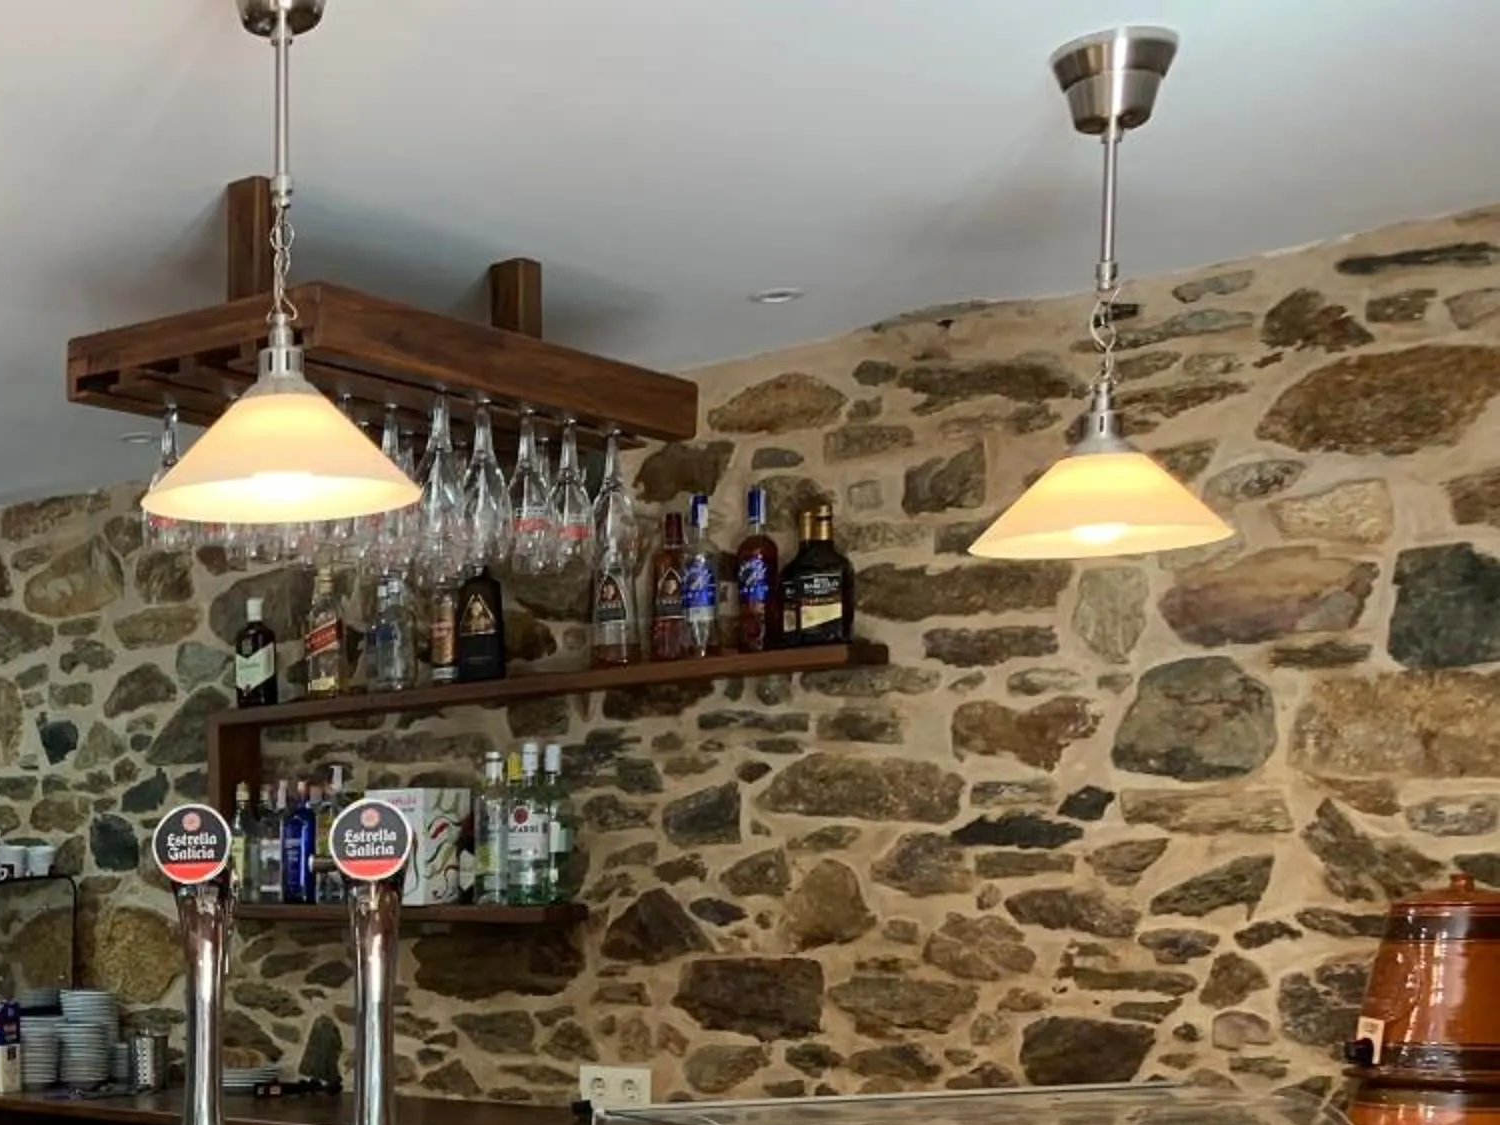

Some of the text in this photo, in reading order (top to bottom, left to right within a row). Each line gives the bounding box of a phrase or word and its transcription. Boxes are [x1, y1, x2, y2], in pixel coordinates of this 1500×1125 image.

[167, 832, 217, 846] Estrella
[344, 828, 397, 842] Estrella
[167, 846, 215, 860] Galicia
[345, 843, 395, 857] Galicia
